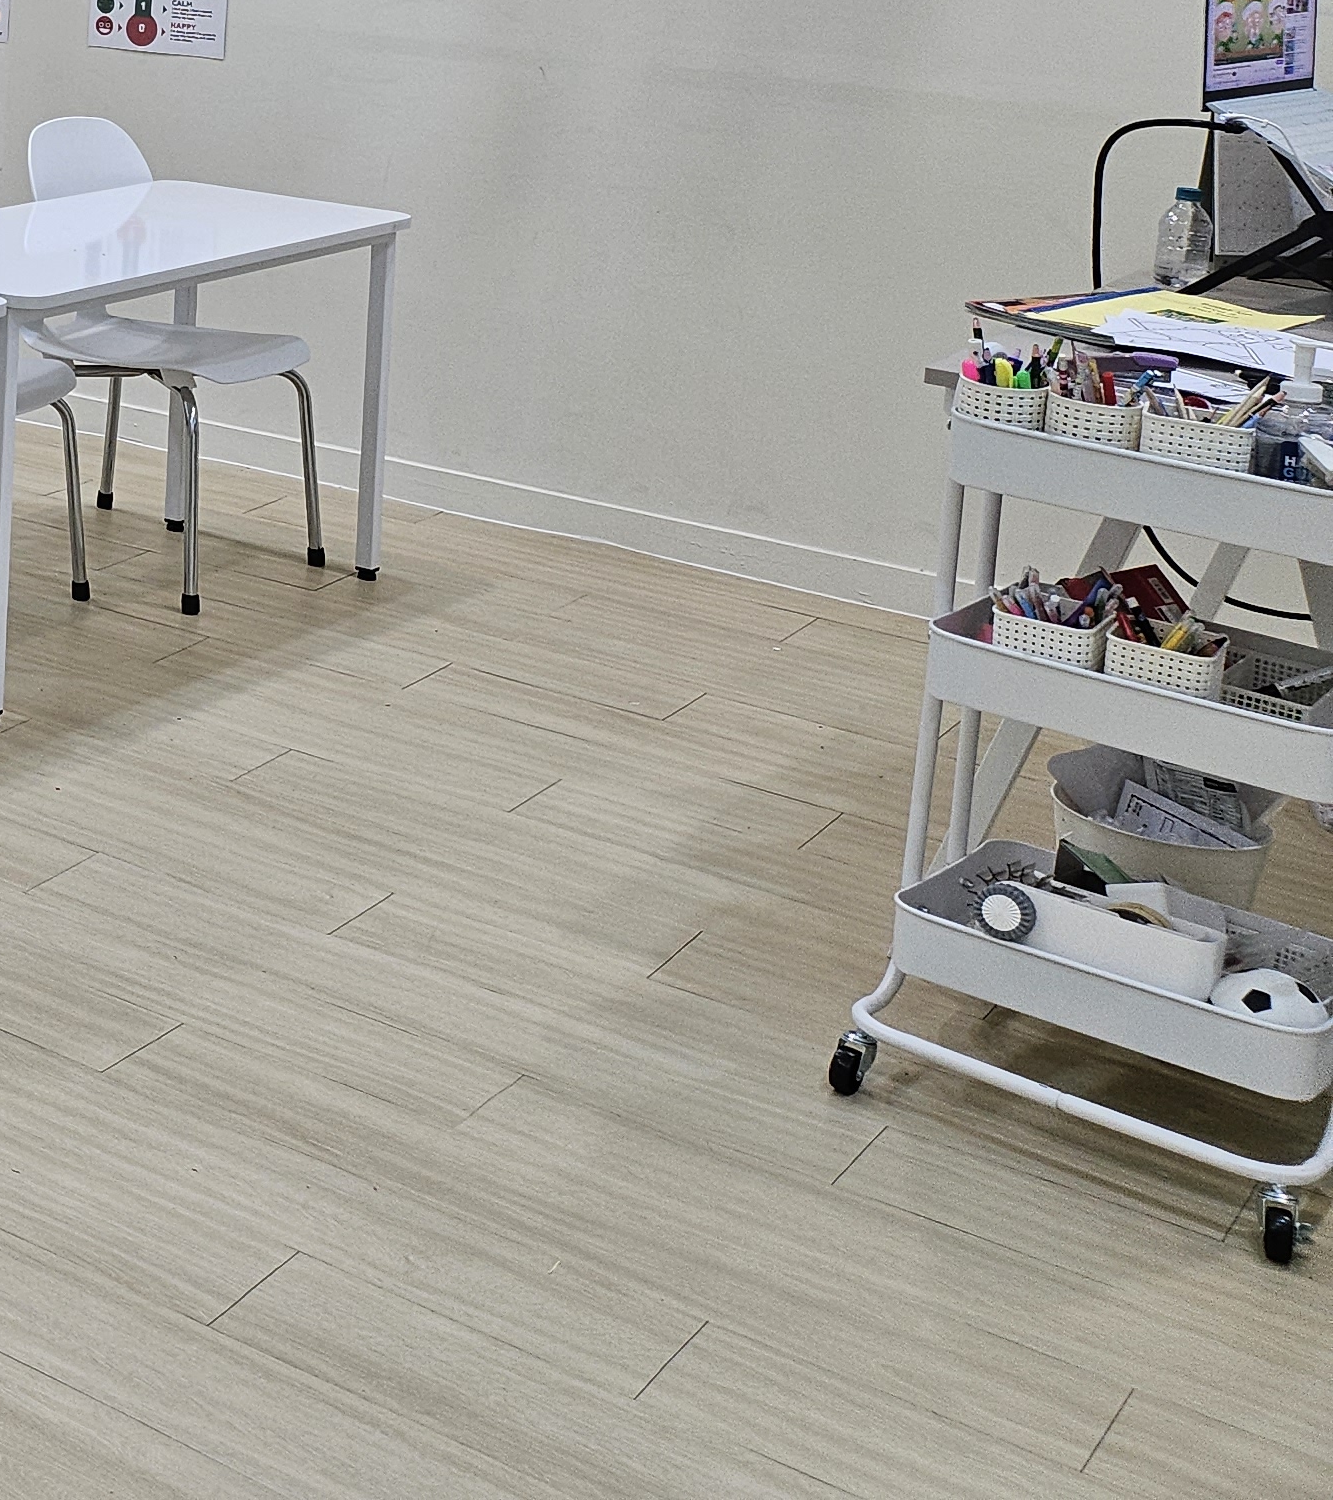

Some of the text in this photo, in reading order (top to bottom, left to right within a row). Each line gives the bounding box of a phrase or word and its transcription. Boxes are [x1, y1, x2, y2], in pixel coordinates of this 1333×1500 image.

[140, 2, 146, 11] 1
[172, 0, 193, 8] CALM
[170, 22, 196, 31] HAPPY
